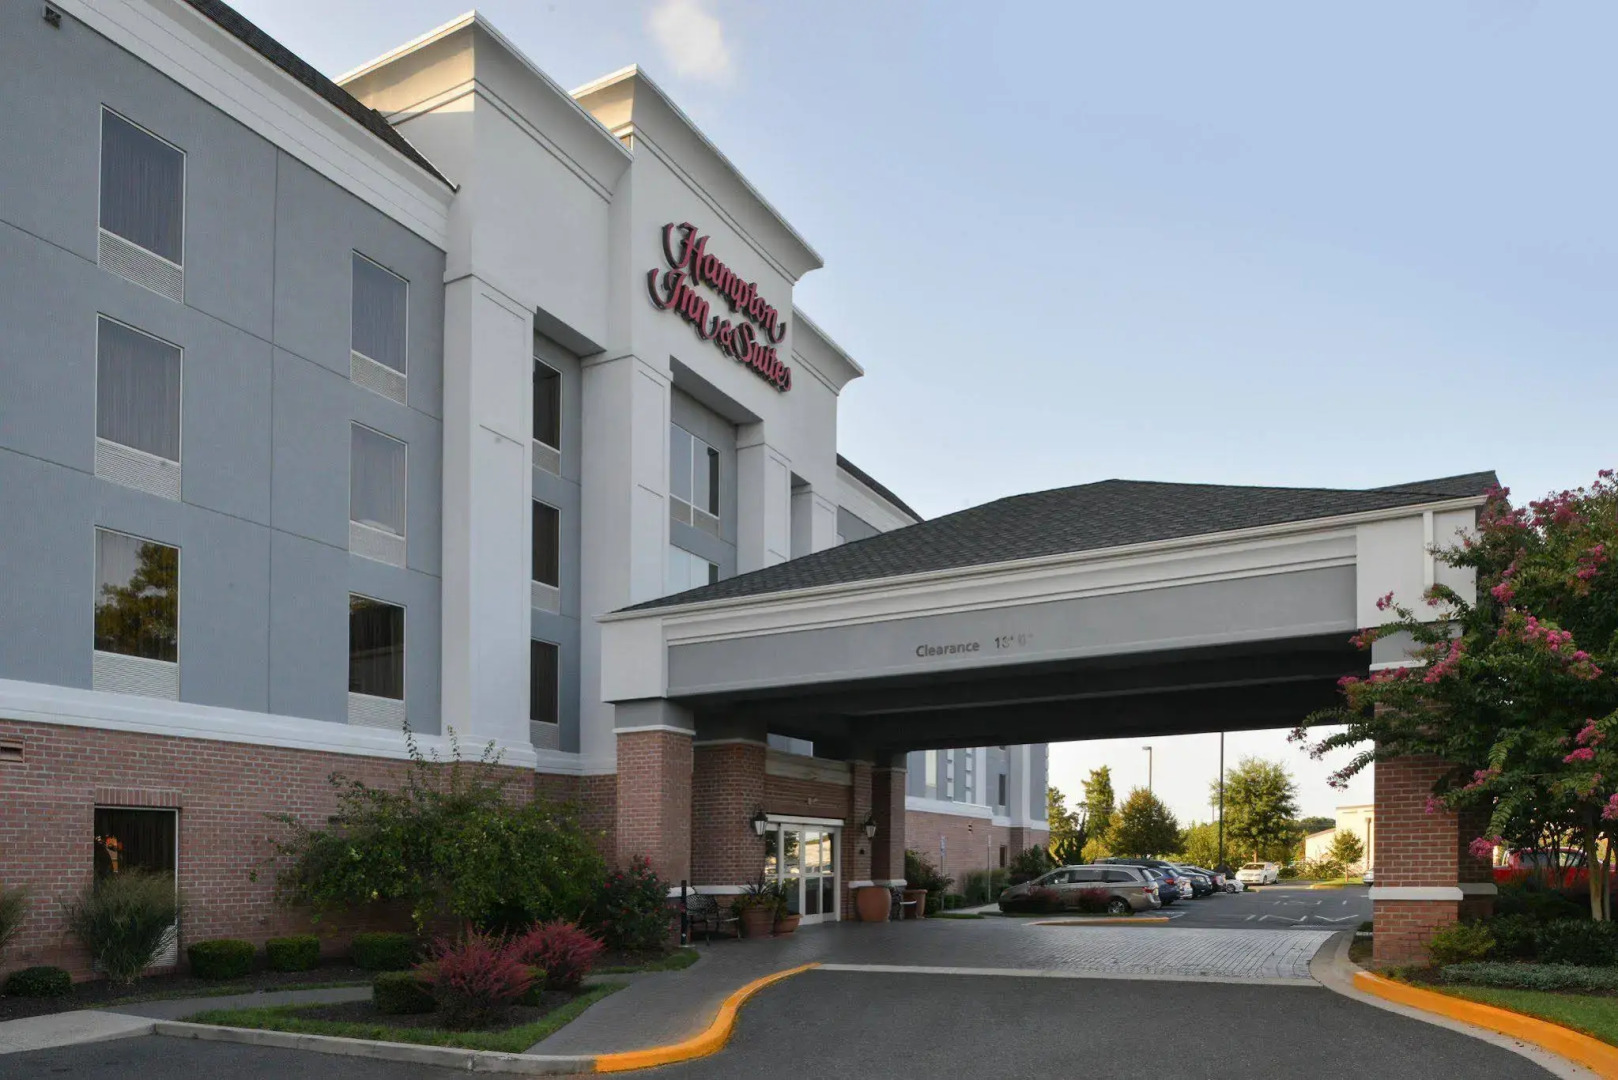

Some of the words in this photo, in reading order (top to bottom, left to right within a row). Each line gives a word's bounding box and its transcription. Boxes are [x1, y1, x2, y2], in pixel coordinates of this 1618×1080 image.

[647, 268, 720, 341] Inn
[730, 321, 792, 392] Suites
[662, 222, 786, 344] Hampton
[916, 642, 980, 657] Clearance
